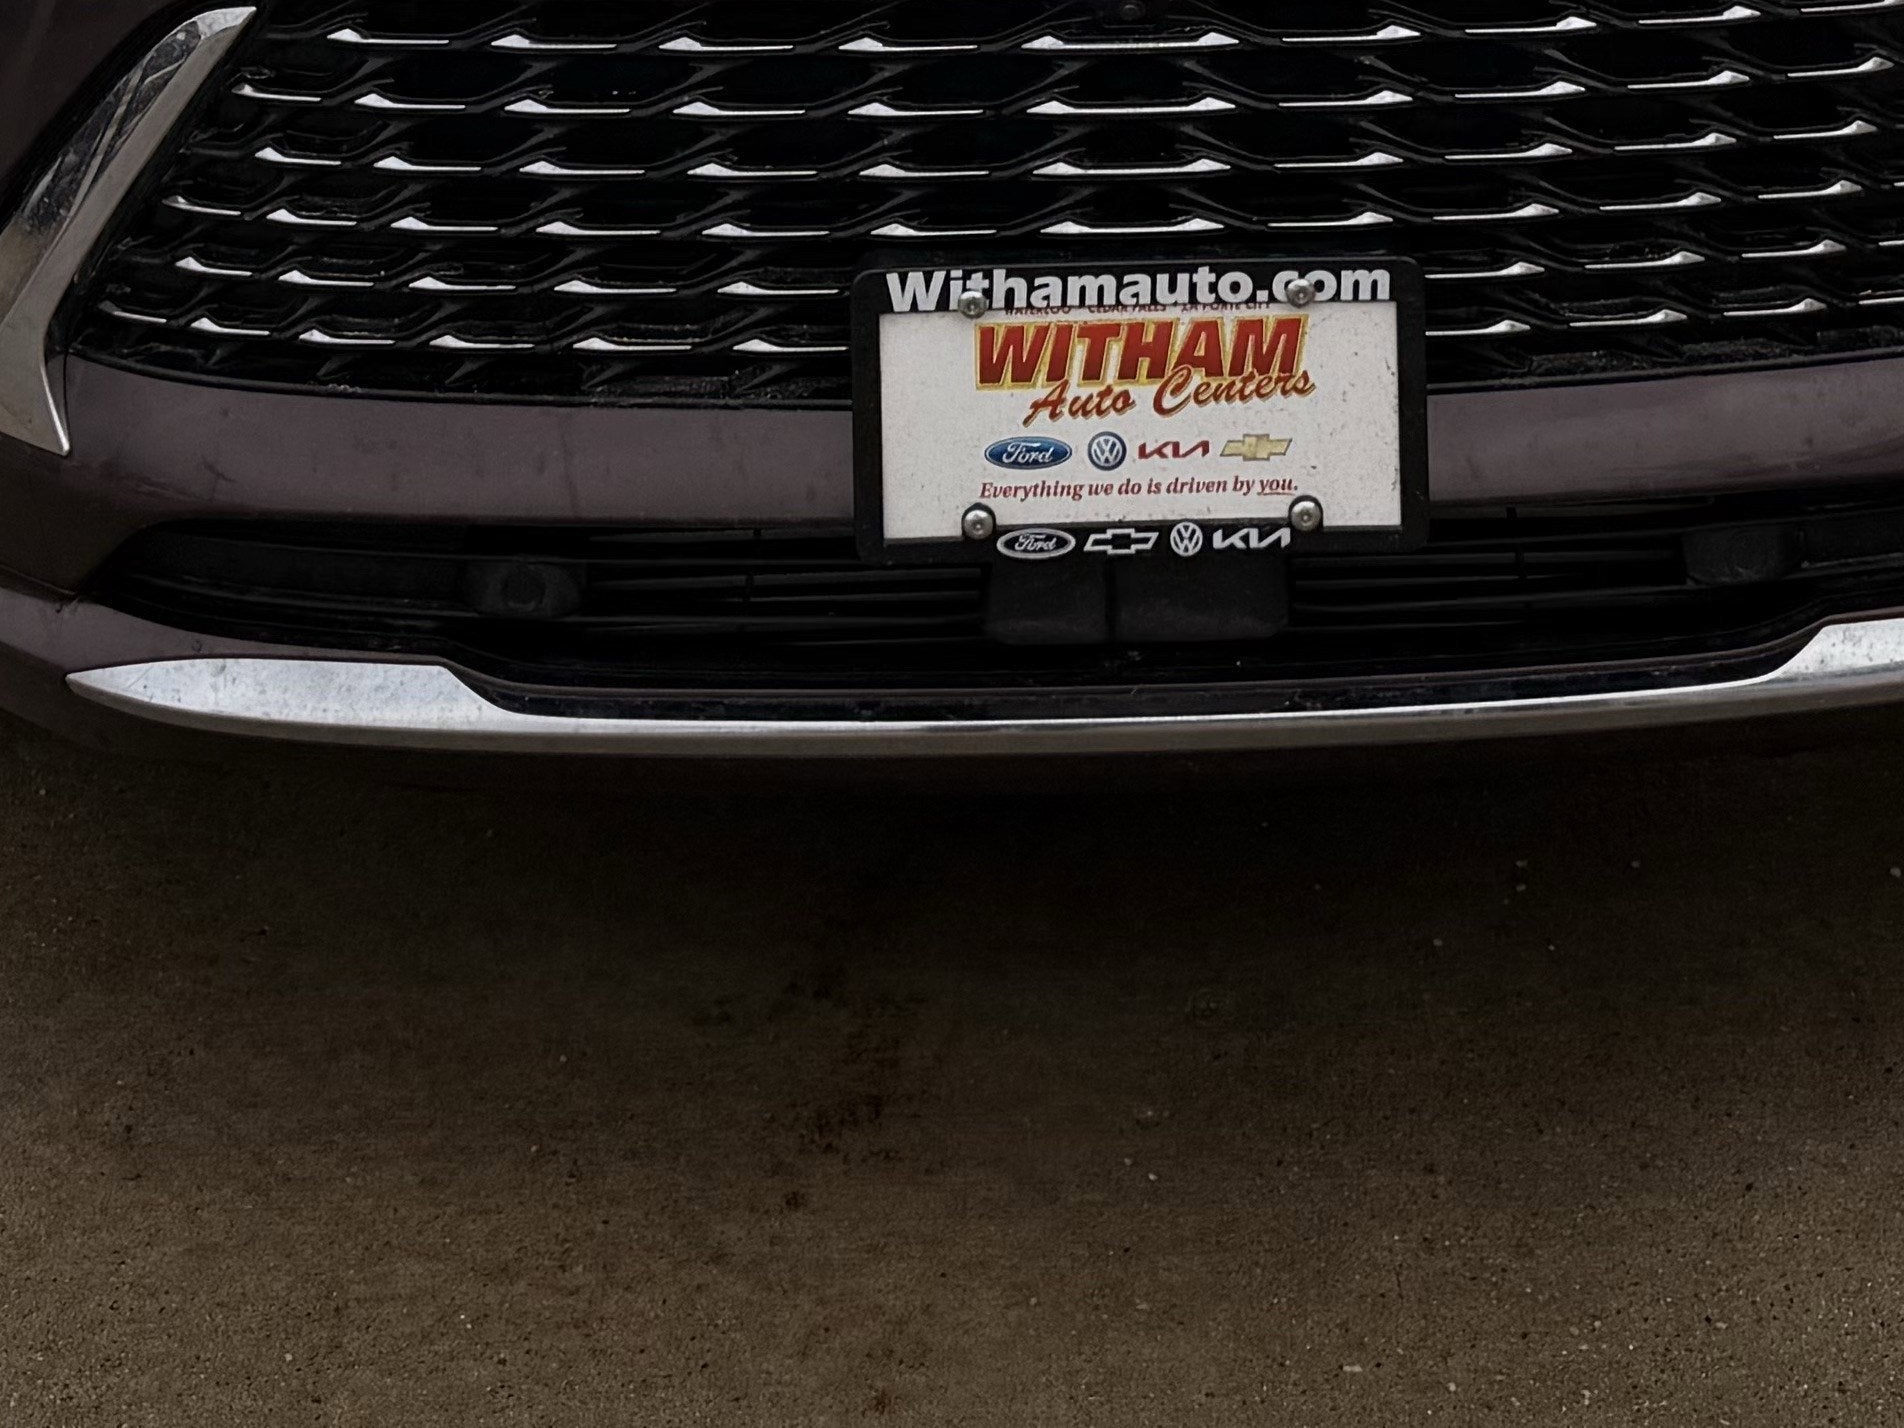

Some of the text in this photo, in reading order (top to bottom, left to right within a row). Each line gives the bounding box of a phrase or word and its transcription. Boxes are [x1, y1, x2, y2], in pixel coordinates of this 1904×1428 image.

[885, 266, 1391, 312] Withamauto.com
[976, 315, 1307, 388] WITHAM
[1022, 365, 1316, 428] Auto Centers
[980, 475, 1298, 502] Everything we do is driven by you.
